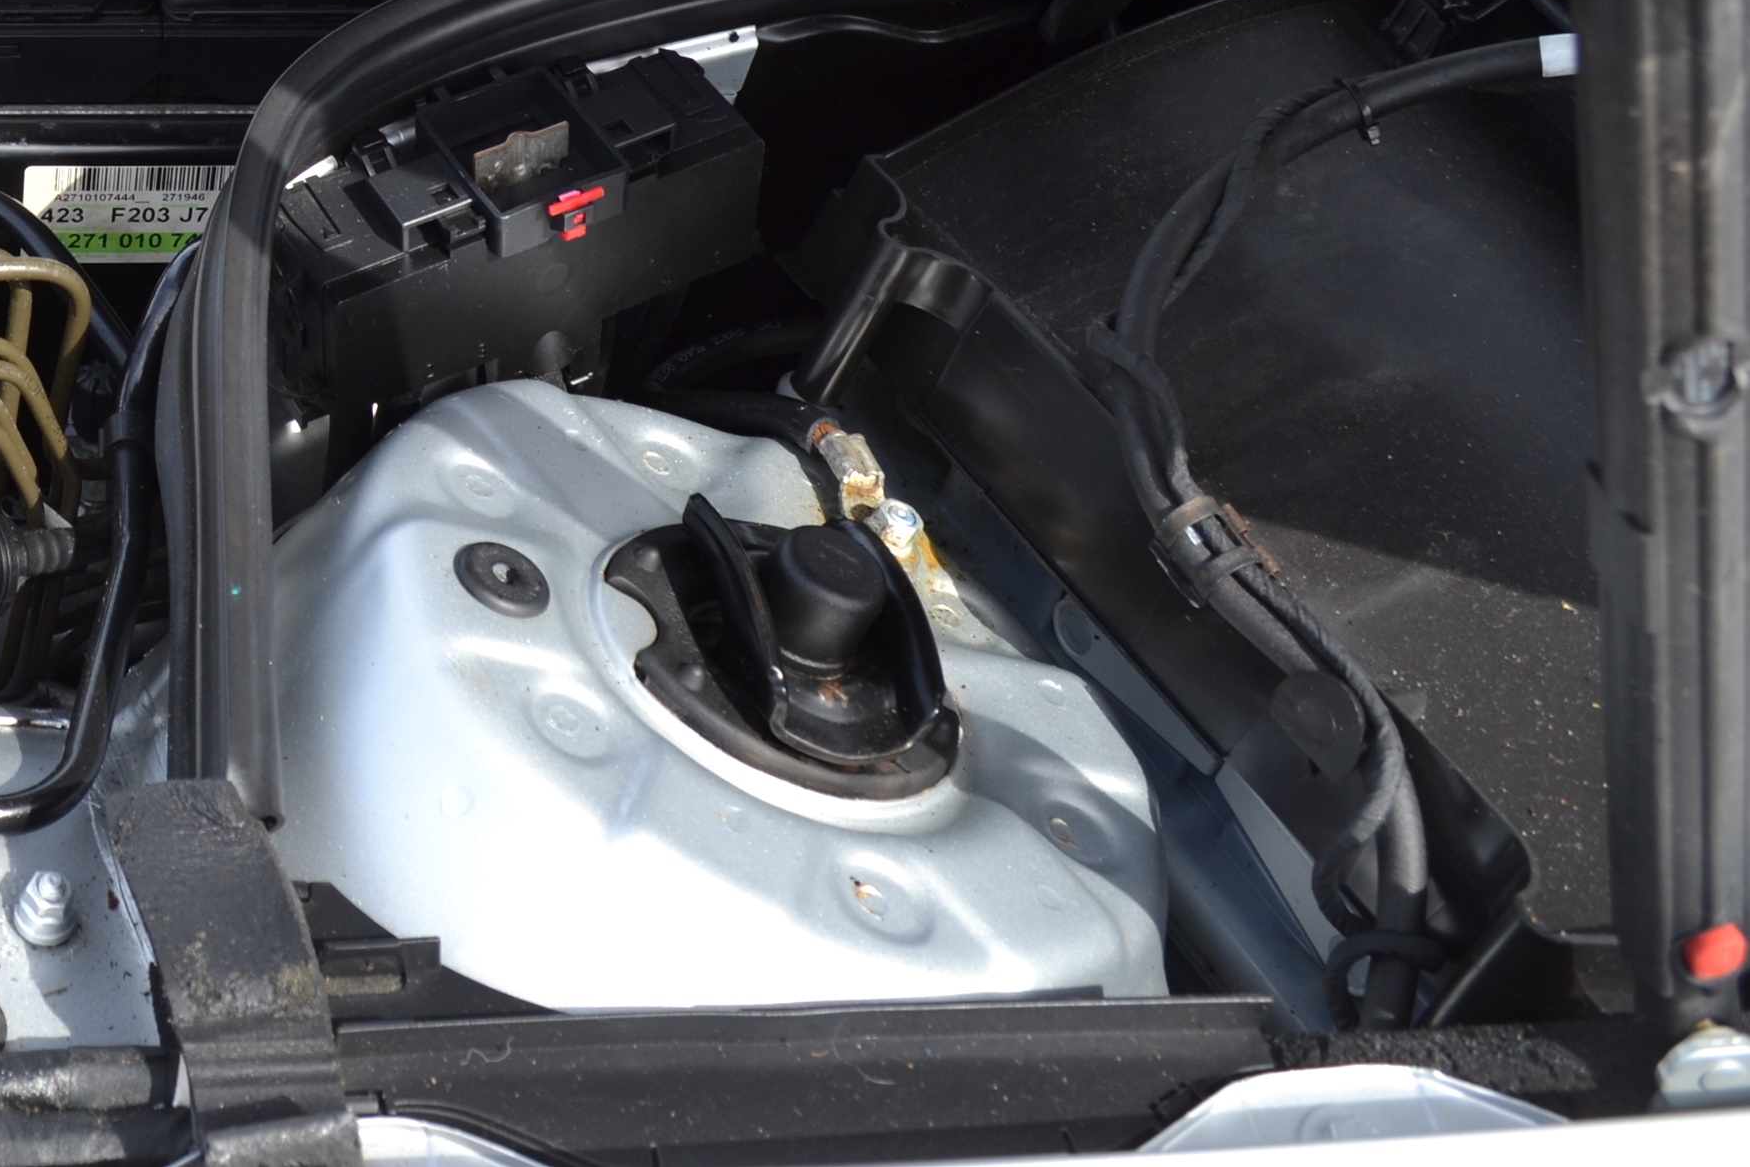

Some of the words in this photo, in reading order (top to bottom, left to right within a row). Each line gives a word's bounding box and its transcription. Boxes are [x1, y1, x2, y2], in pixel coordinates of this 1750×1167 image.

[41, 208, 84, 223] 423
[111, 208, 170, 223] F203
[179, 207, 208, 222] J7
[67, 233, 108, 248] 271
[119, 233, 162, 248] 010
